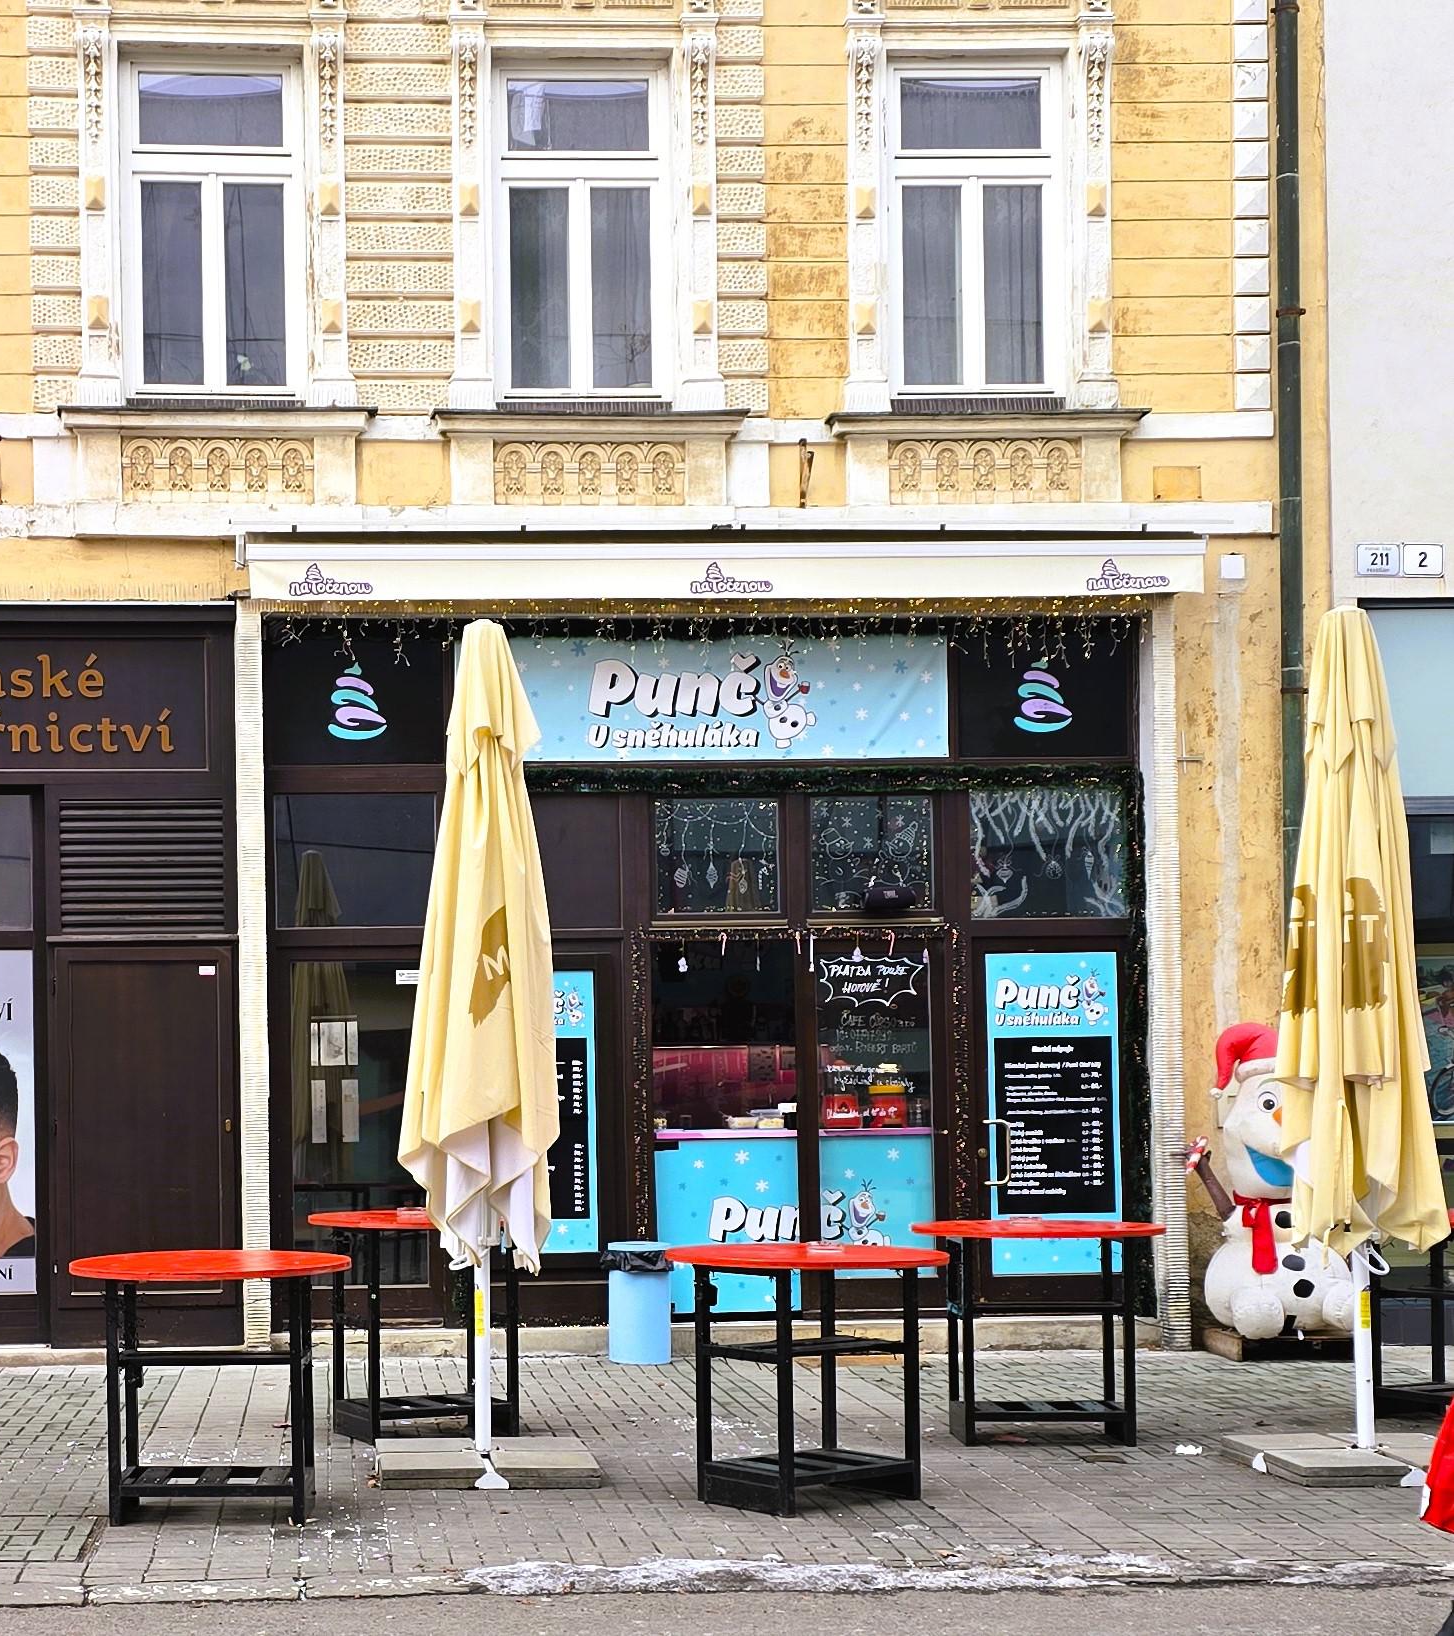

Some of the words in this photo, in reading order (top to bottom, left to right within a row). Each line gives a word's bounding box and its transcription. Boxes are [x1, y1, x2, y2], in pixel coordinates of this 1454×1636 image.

[1370, 552, 1389, 566] 211
[1418, 551, 1428, 568] 2
[587, 651, 762, 718] Punč
[587, 723, 610, 749] U
[611, 720, 760, 749] sněhuláka
[994, 974, 1081, 1010] Punč
[994, 1012, 1006, 1026] U
[1006, 1010, 1081, 1026] sněhuláka
